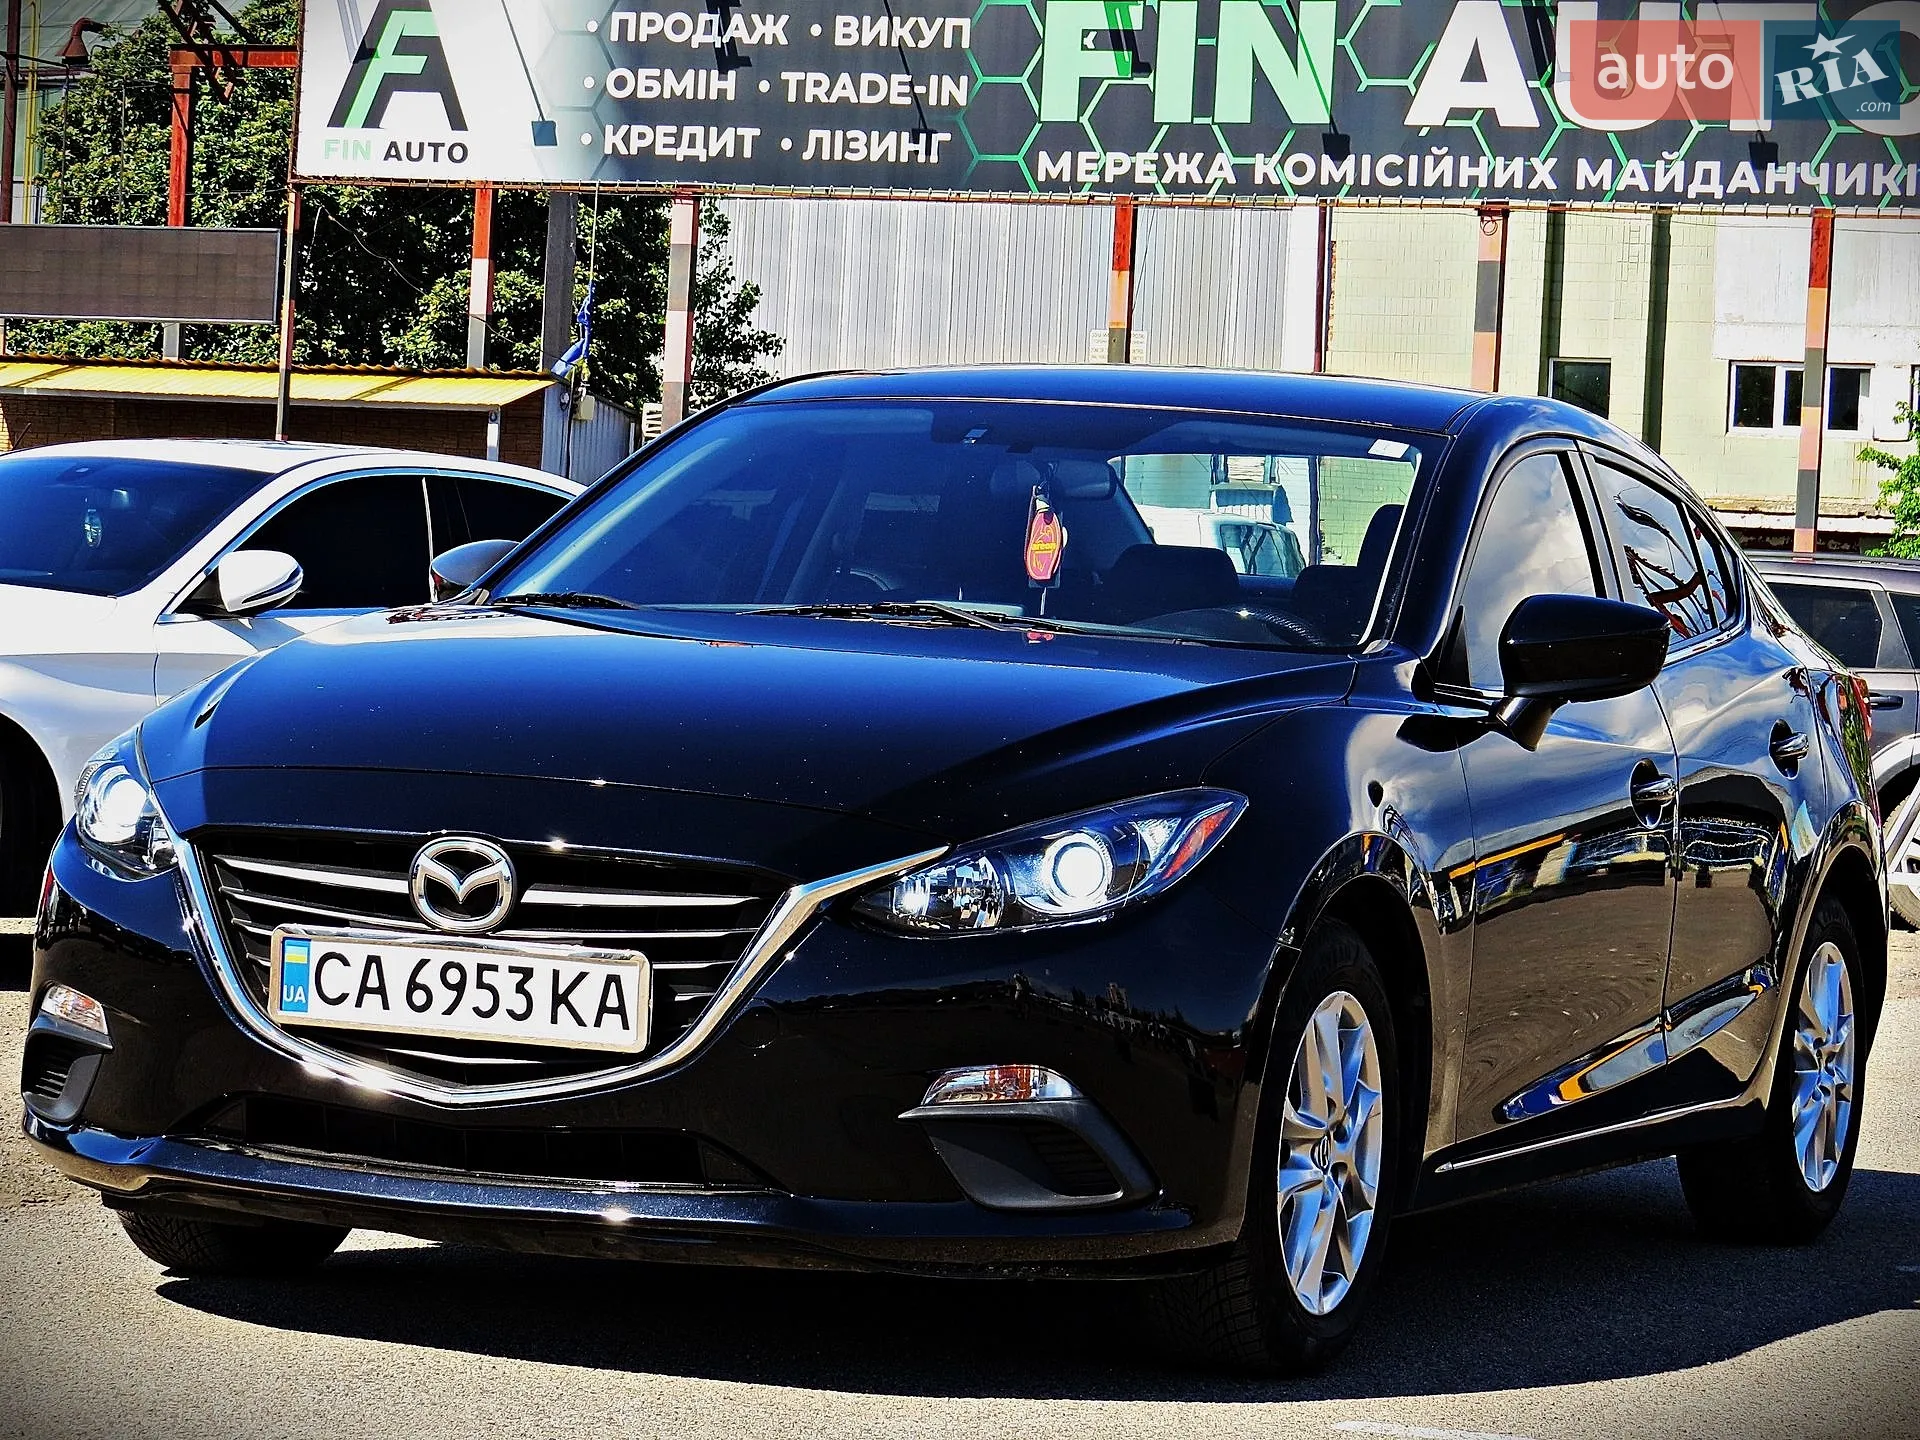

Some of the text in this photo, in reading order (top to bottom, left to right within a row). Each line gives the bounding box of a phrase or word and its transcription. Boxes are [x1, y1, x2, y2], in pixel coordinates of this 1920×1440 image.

[609, 11, 972, 48] ПРОДАЖ ВИКУП
[1039, 0, 1337, 124] FIN
[605, 67, 969, 106] ОБМІН TRADE-IN
[324, 139, 469, 164] FIN AUTO
[603, 124, 952, 164] КРЕДИТ ЛІЗИНГ
[1037, 150, 1237, 185] МЕРЕЖА
[1254, 145, 1558, 191] КОМІСІЙНИХ
[283, 984, 307, 1004] UA
[314, 951, 631, 1032] CA 6953 KA
